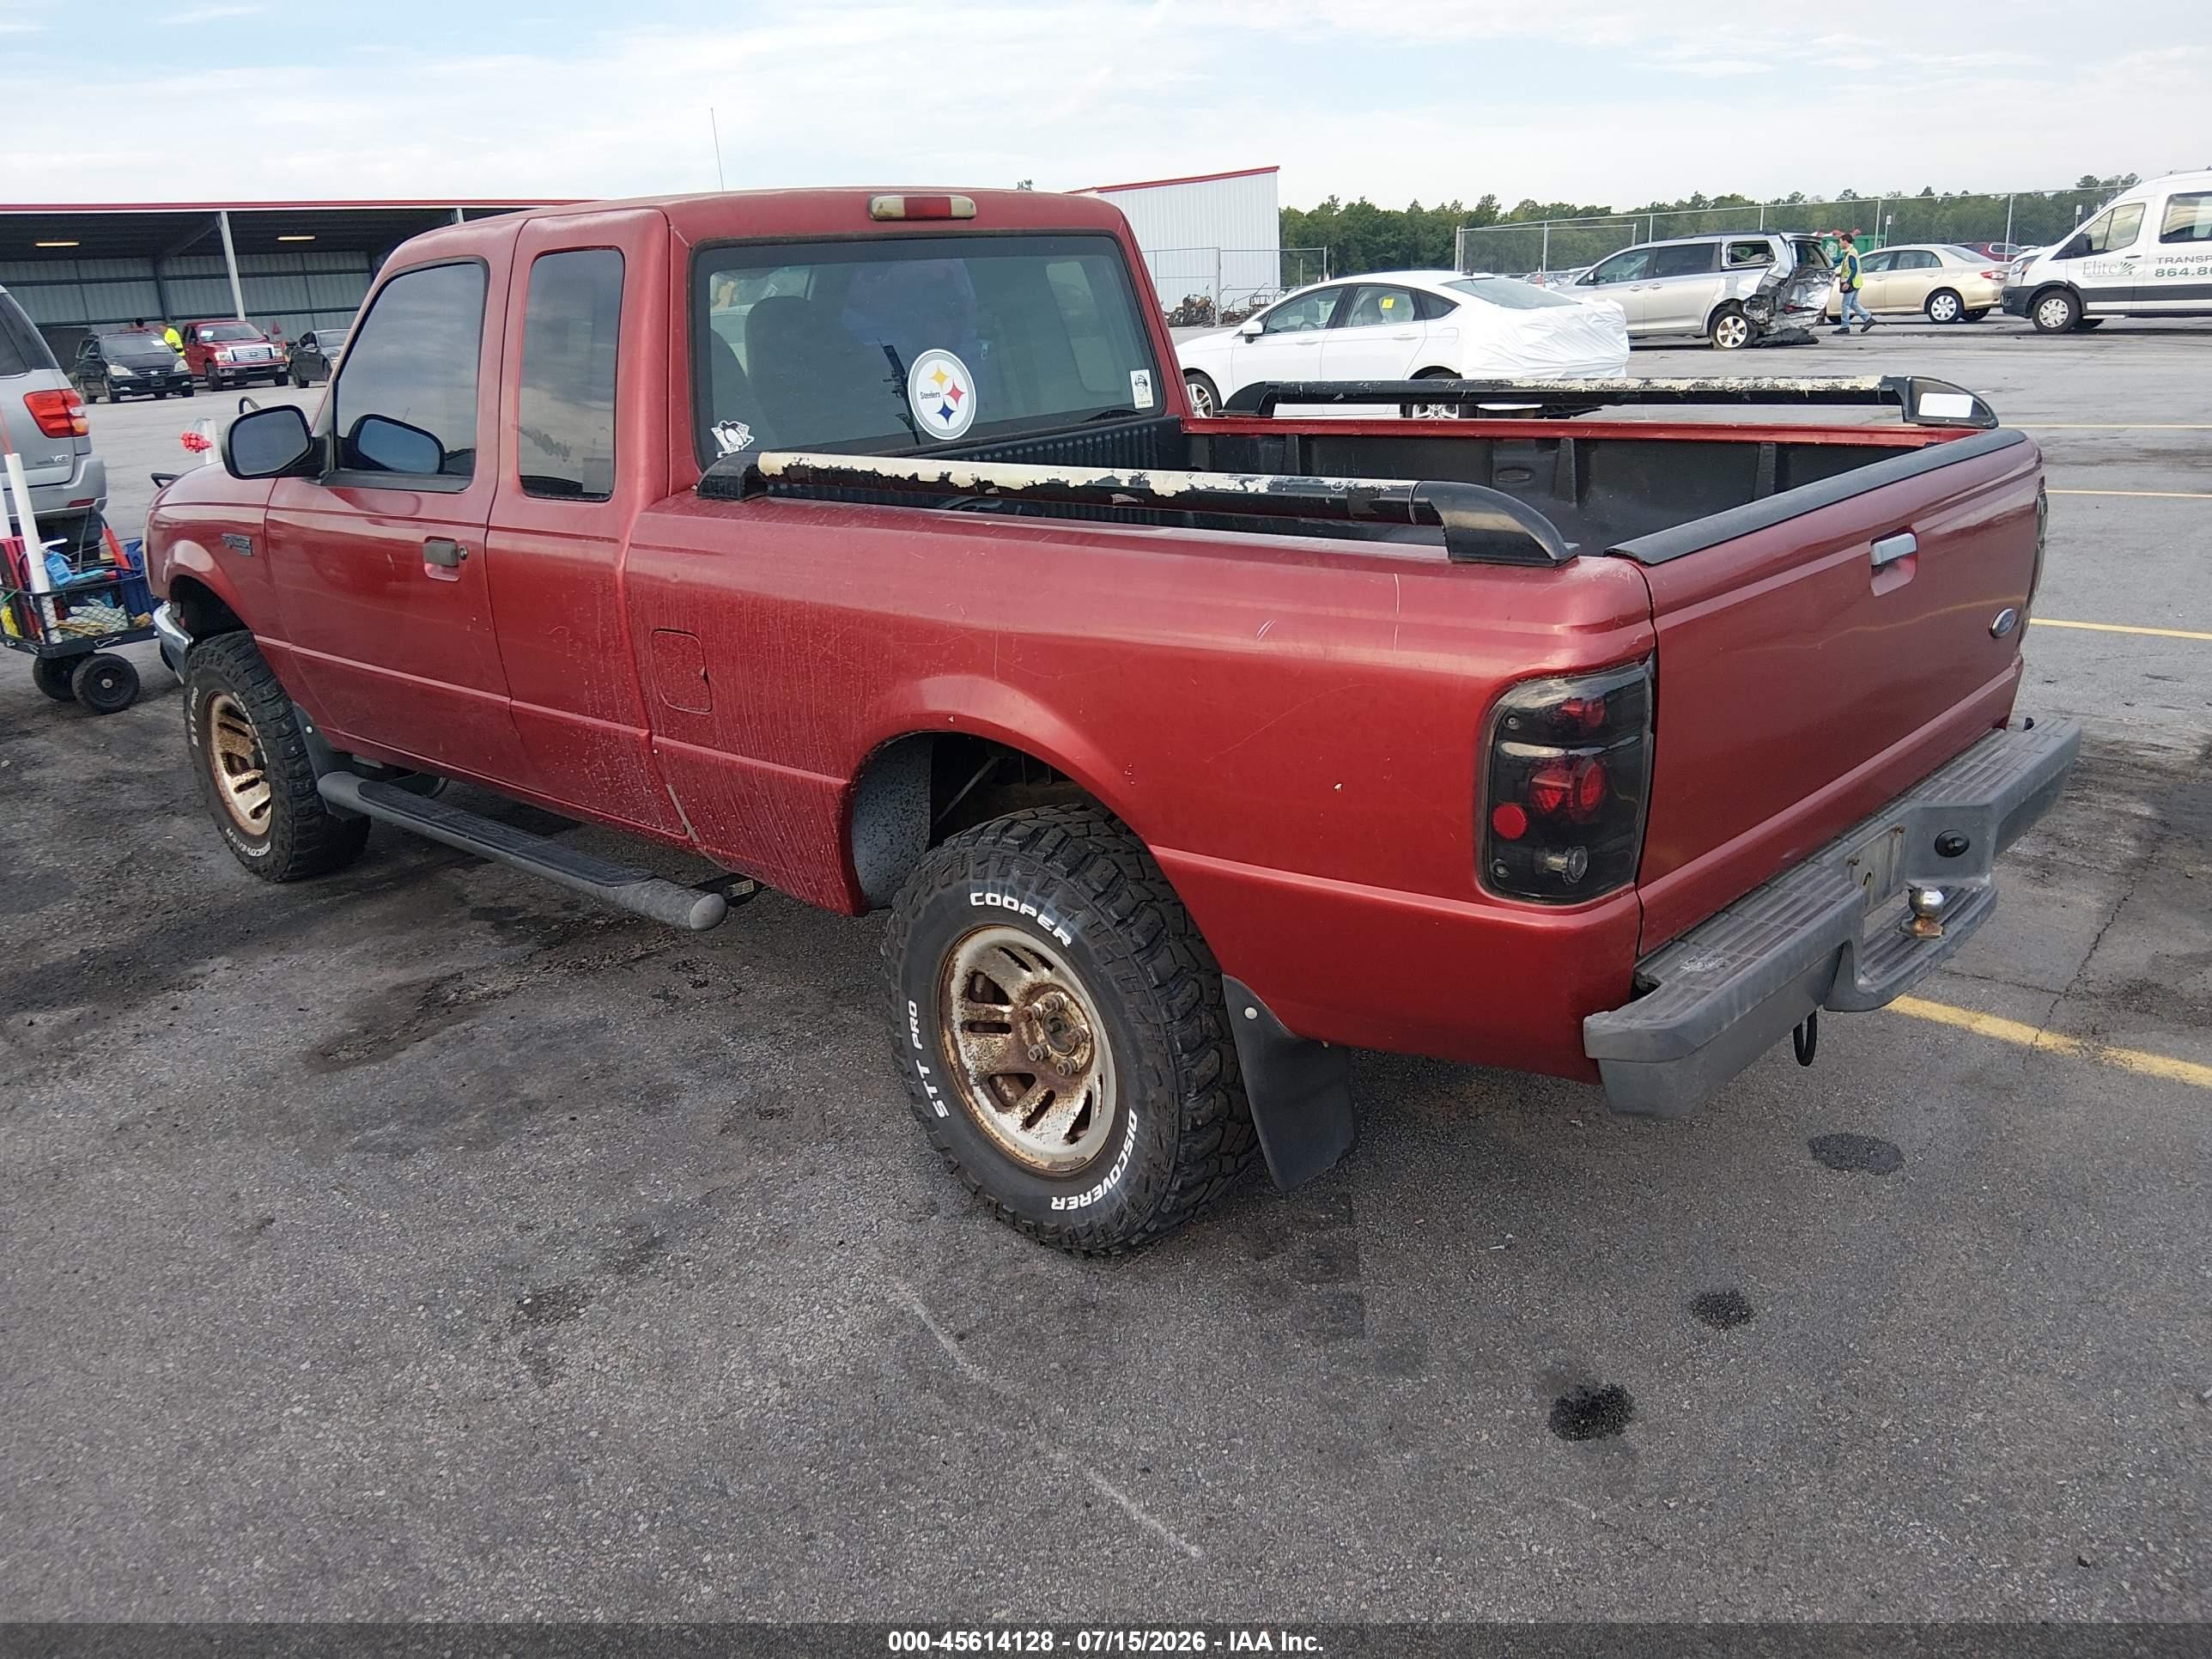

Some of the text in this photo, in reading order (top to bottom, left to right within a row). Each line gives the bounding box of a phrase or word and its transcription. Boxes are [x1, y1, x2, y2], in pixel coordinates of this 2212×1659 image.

[2082, 260, 2118, 276] Elite
[2154, 266, 2212, 277] 864.8
[970, 891, 1073, 947] COOPER
[908, 1000, 950, 1118] STT PRO
[1051, 1108, 1139, 1211] DISCOVERER
